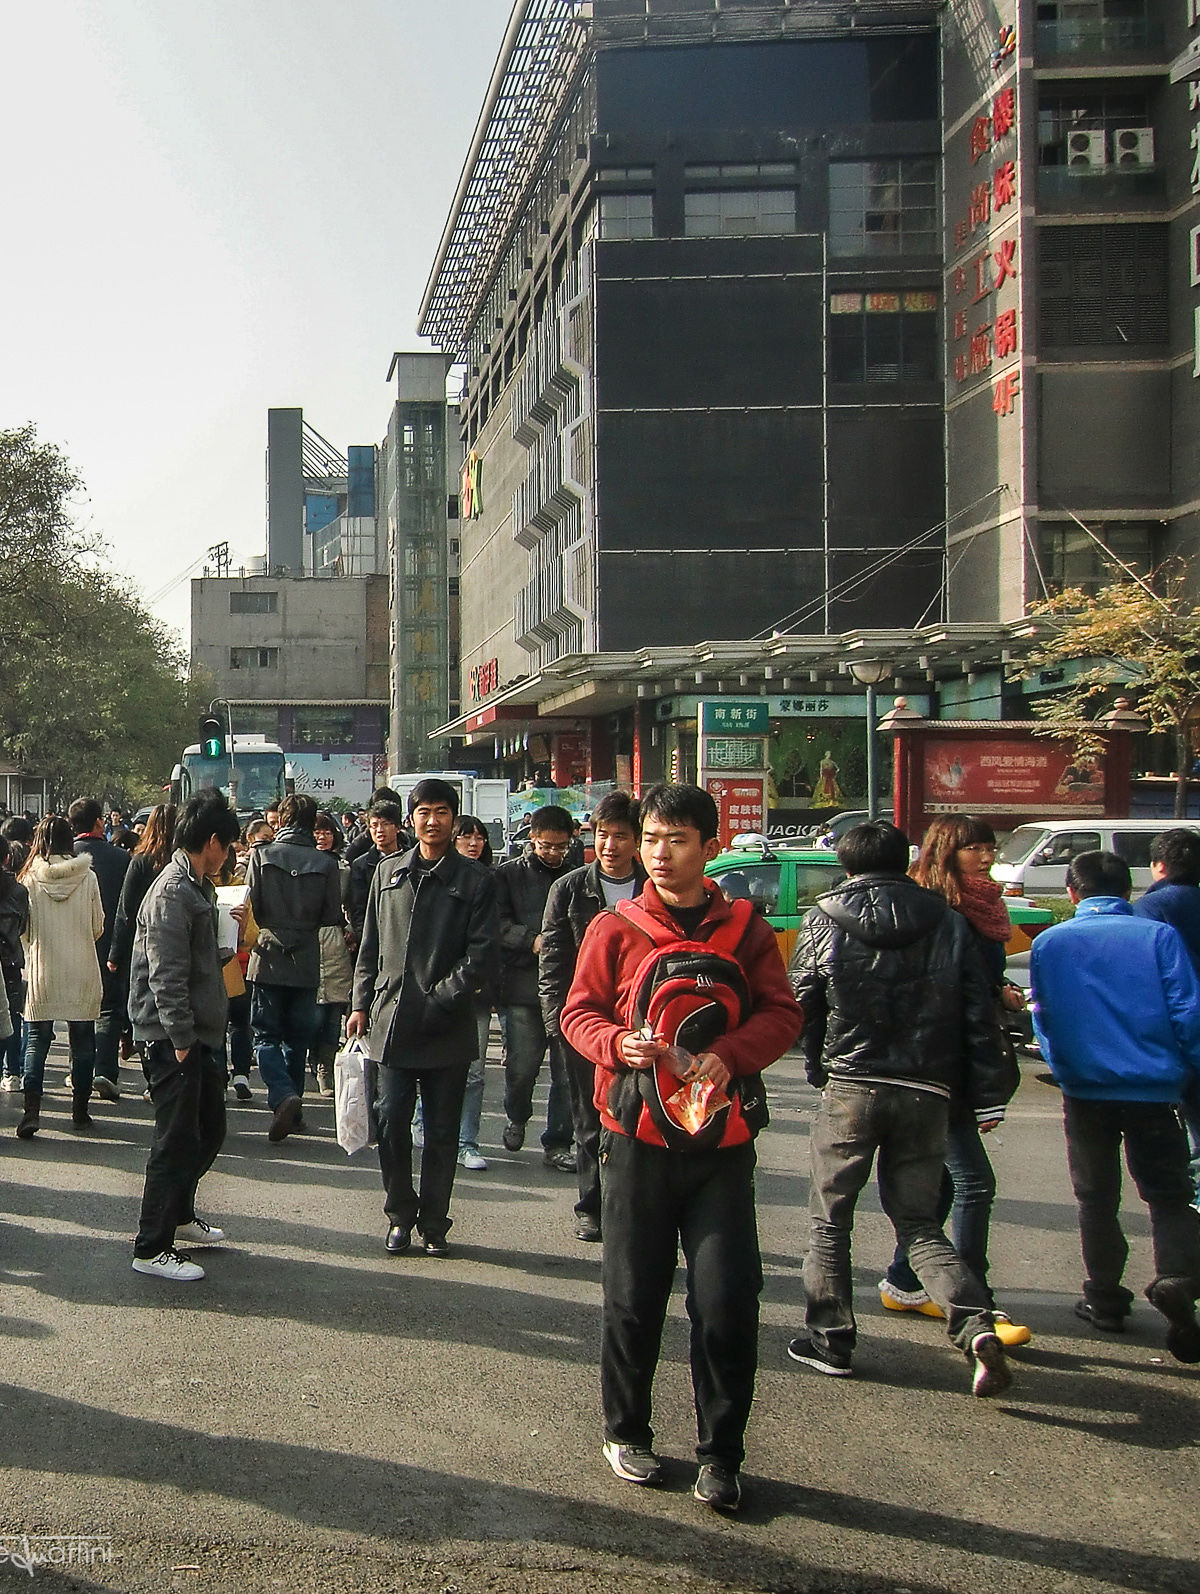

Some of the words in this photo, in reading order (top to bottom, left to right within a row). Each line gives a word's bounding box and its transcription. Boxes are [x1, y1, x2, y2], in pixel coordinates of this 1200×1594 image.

[993, 370, 1019, 416] 4F
[715, 708, 757, 720] 南新街
